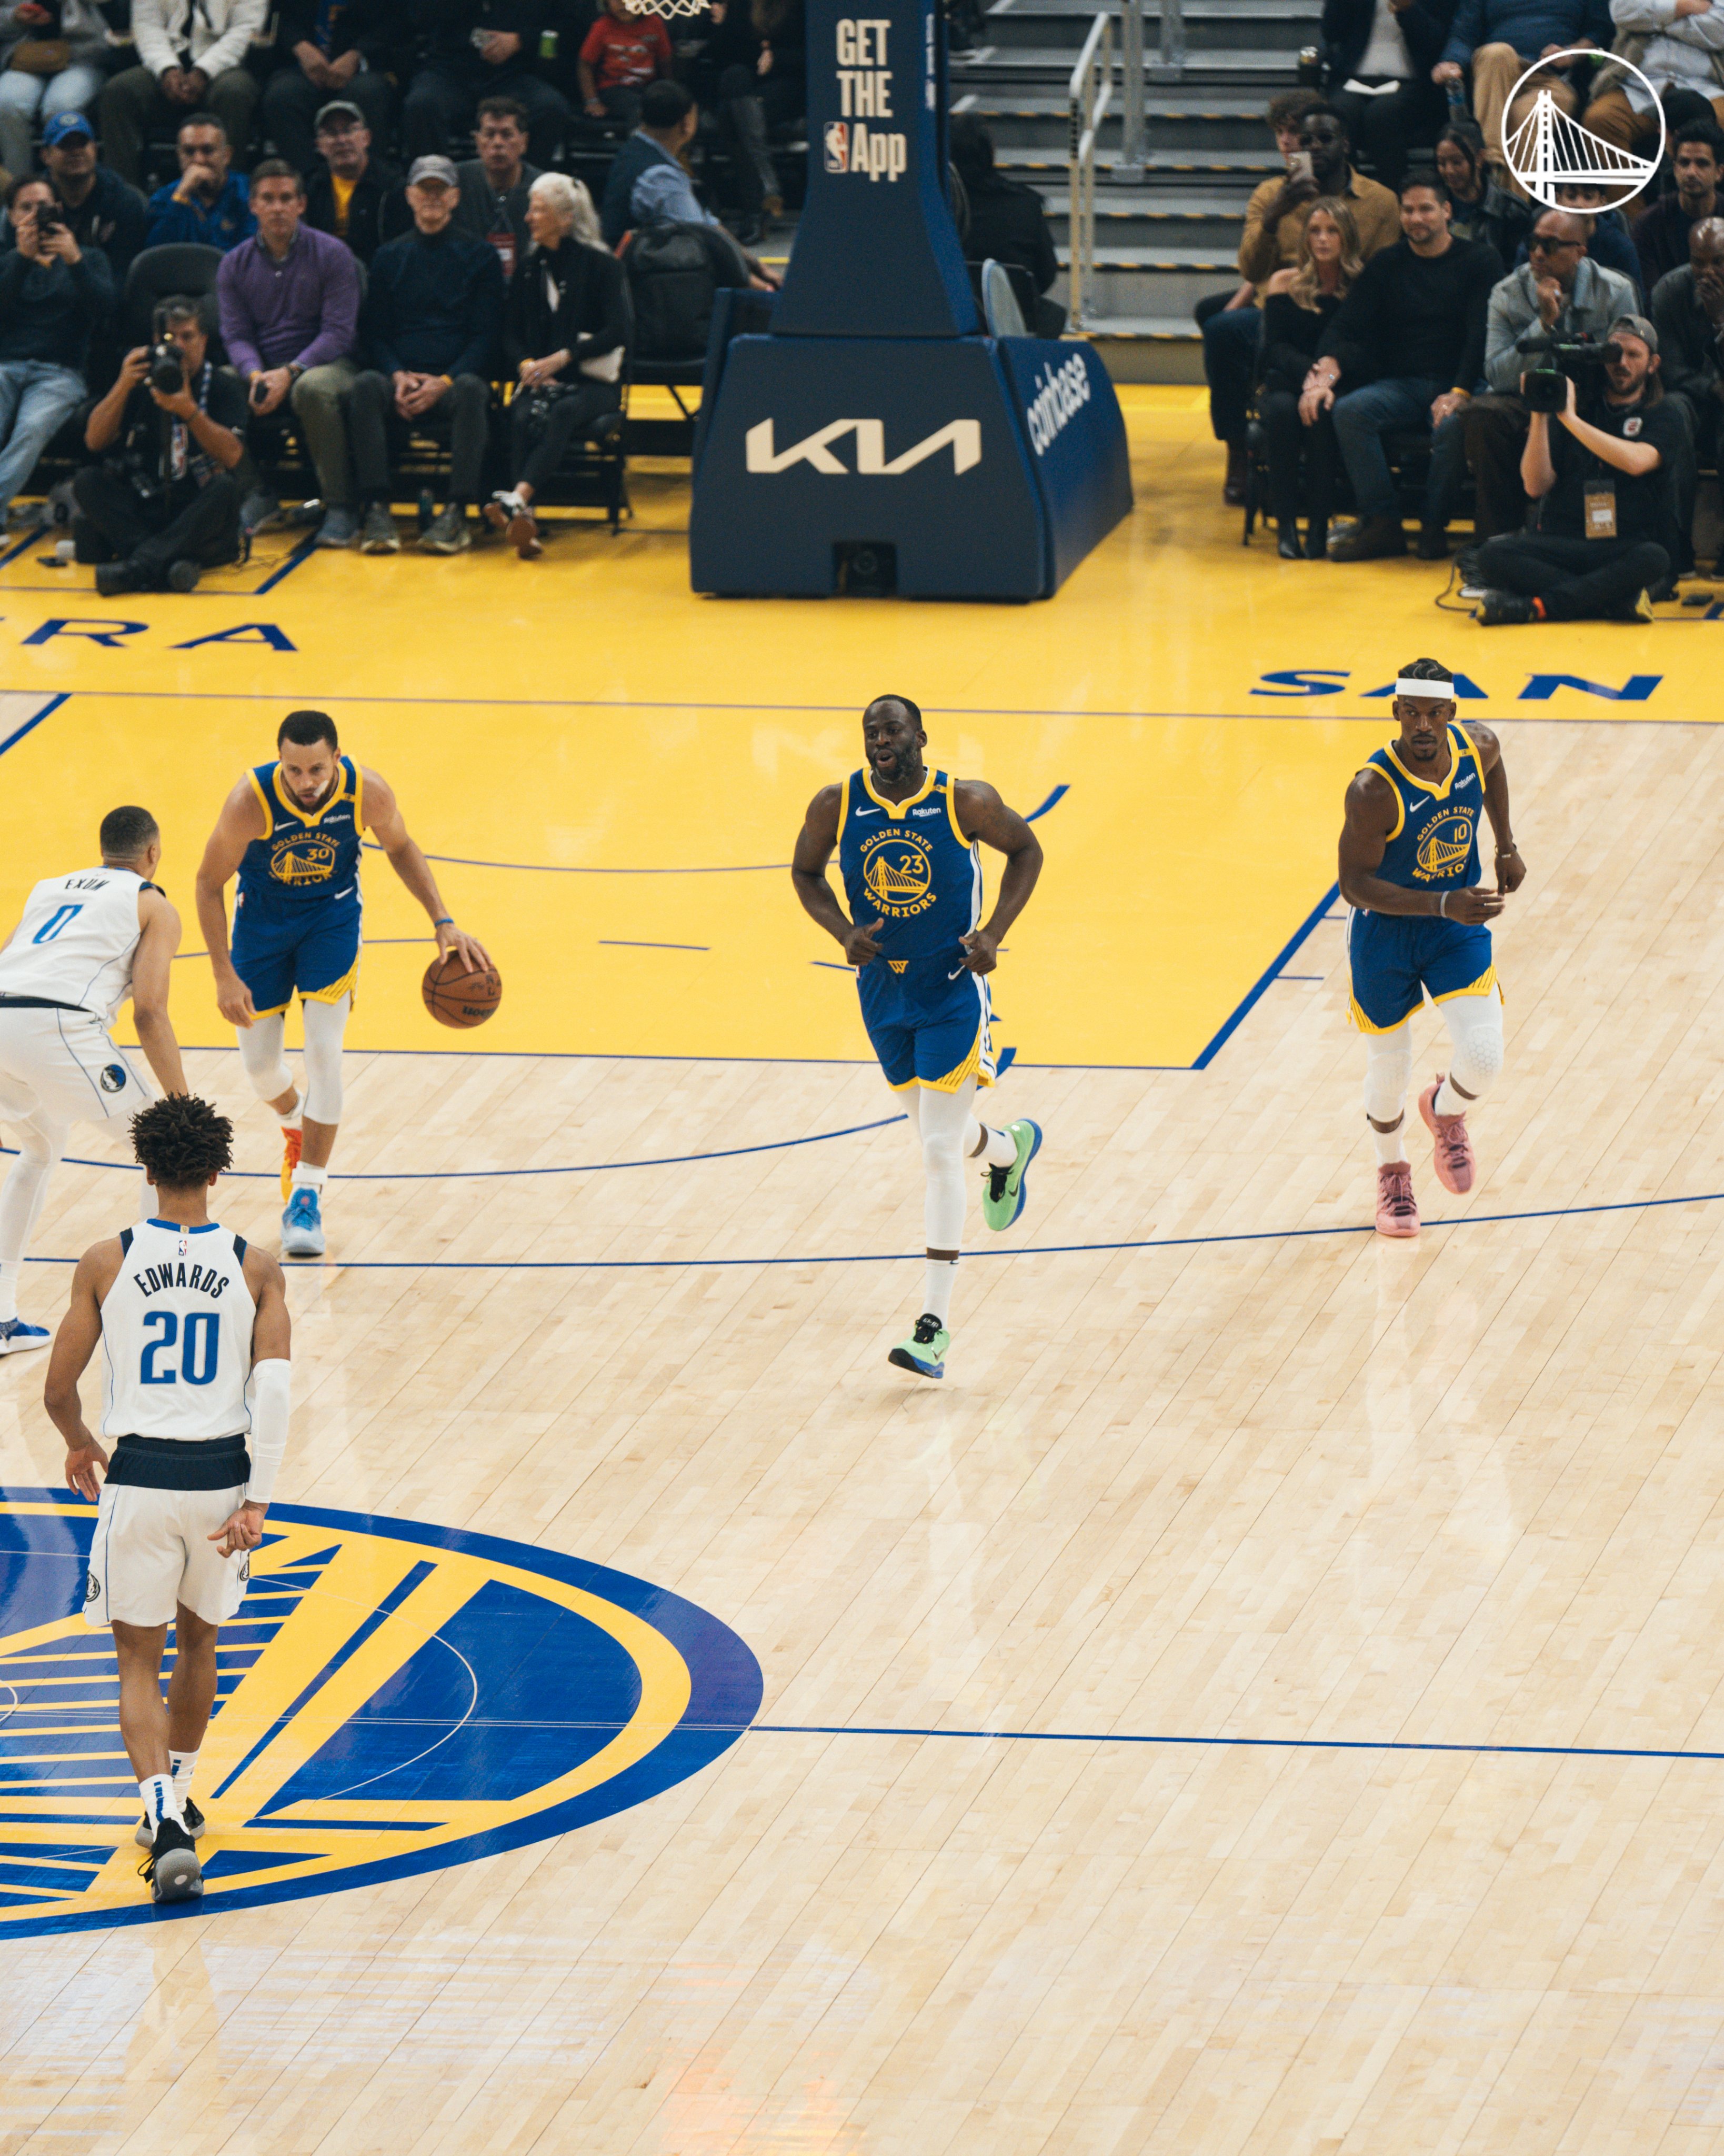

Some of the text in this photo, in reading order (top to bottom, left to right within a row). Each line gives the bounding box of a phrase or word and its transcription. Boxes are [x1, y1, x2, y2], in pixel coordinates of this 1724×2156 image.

[836, 18, 891, 66] GET
[836, 71, 893, 117] THE
[850, 123, 907, 182] App
[1027, 353, 1090, 456] coinbase
[1455, 773, 1476, 790] Rakuten
[912, 807, 941, 817] Rakuten
[1417, 808, 1449, 841] GOLDEN
[272, 832, 312, 851] GOLDEN
[860, 829, 933, 852] GOLDEN STATE
[1454, 824, 1467, 843] 10
[306, 848, 330, 861] 30
[899, 855, 924, 874] 23
[864, 887, 937, 917] WARRIORS
[32, 903, 84, 944] 0
[133, 1262, 229, 1299] EDWARDS
[140, 1310, 221, 1385] 20
